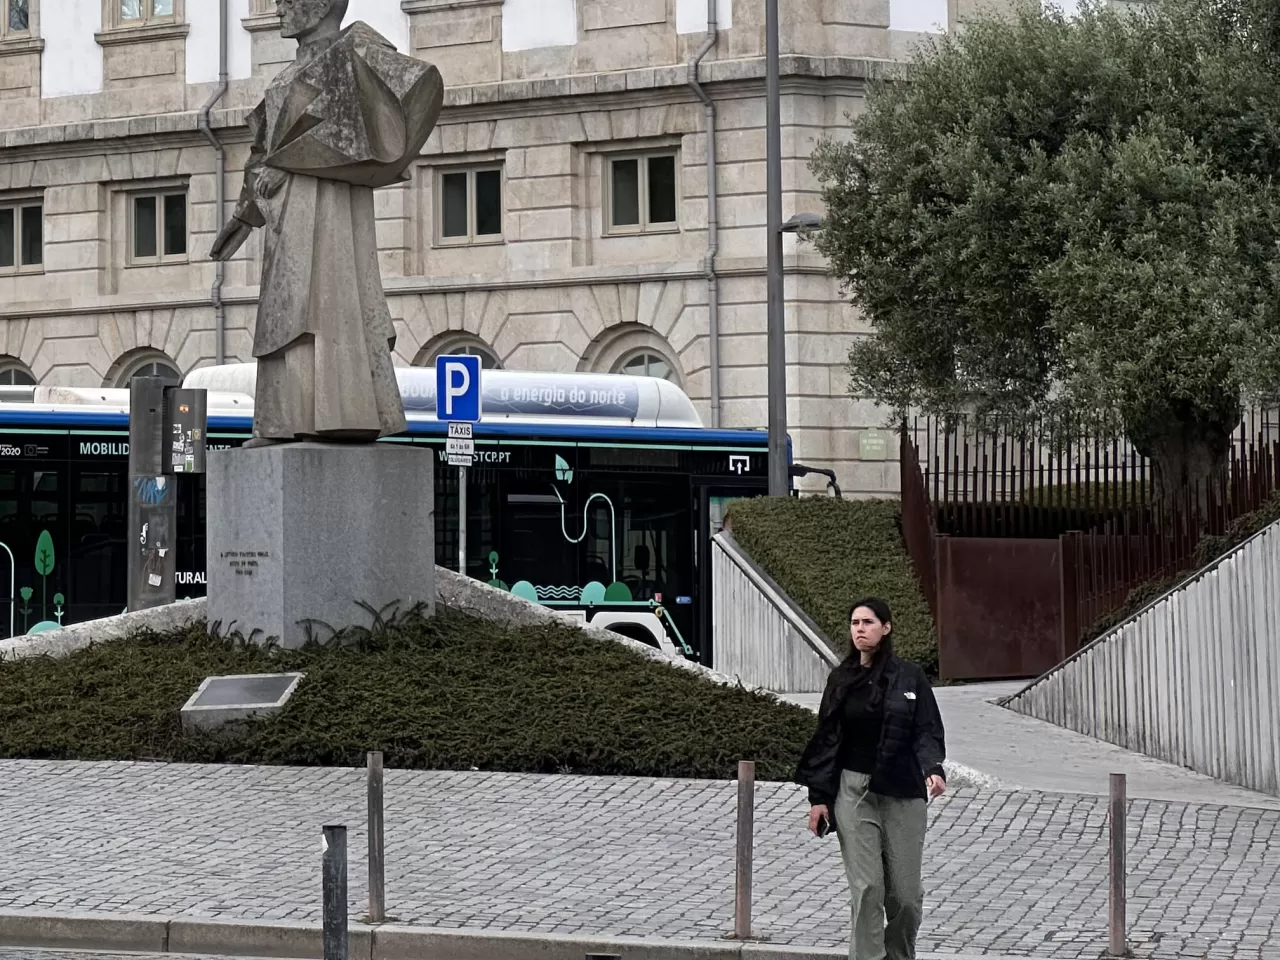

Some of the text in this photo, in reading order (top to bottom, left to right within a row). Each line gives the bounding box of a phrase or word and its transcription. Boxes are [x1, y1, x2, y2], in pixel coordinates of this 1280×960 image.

[445, 362, 470, 414] P
[500, 385, 626, 406] a energia do norte
[450, 424, 470, 436] TÁXIS
[1, 447, 21, 456] 2020
[80, 442, 130, 454] MOBILID
[438, 450, 511, 462] WSTCP.PT
[175, 572, 207, 584] TURAL
